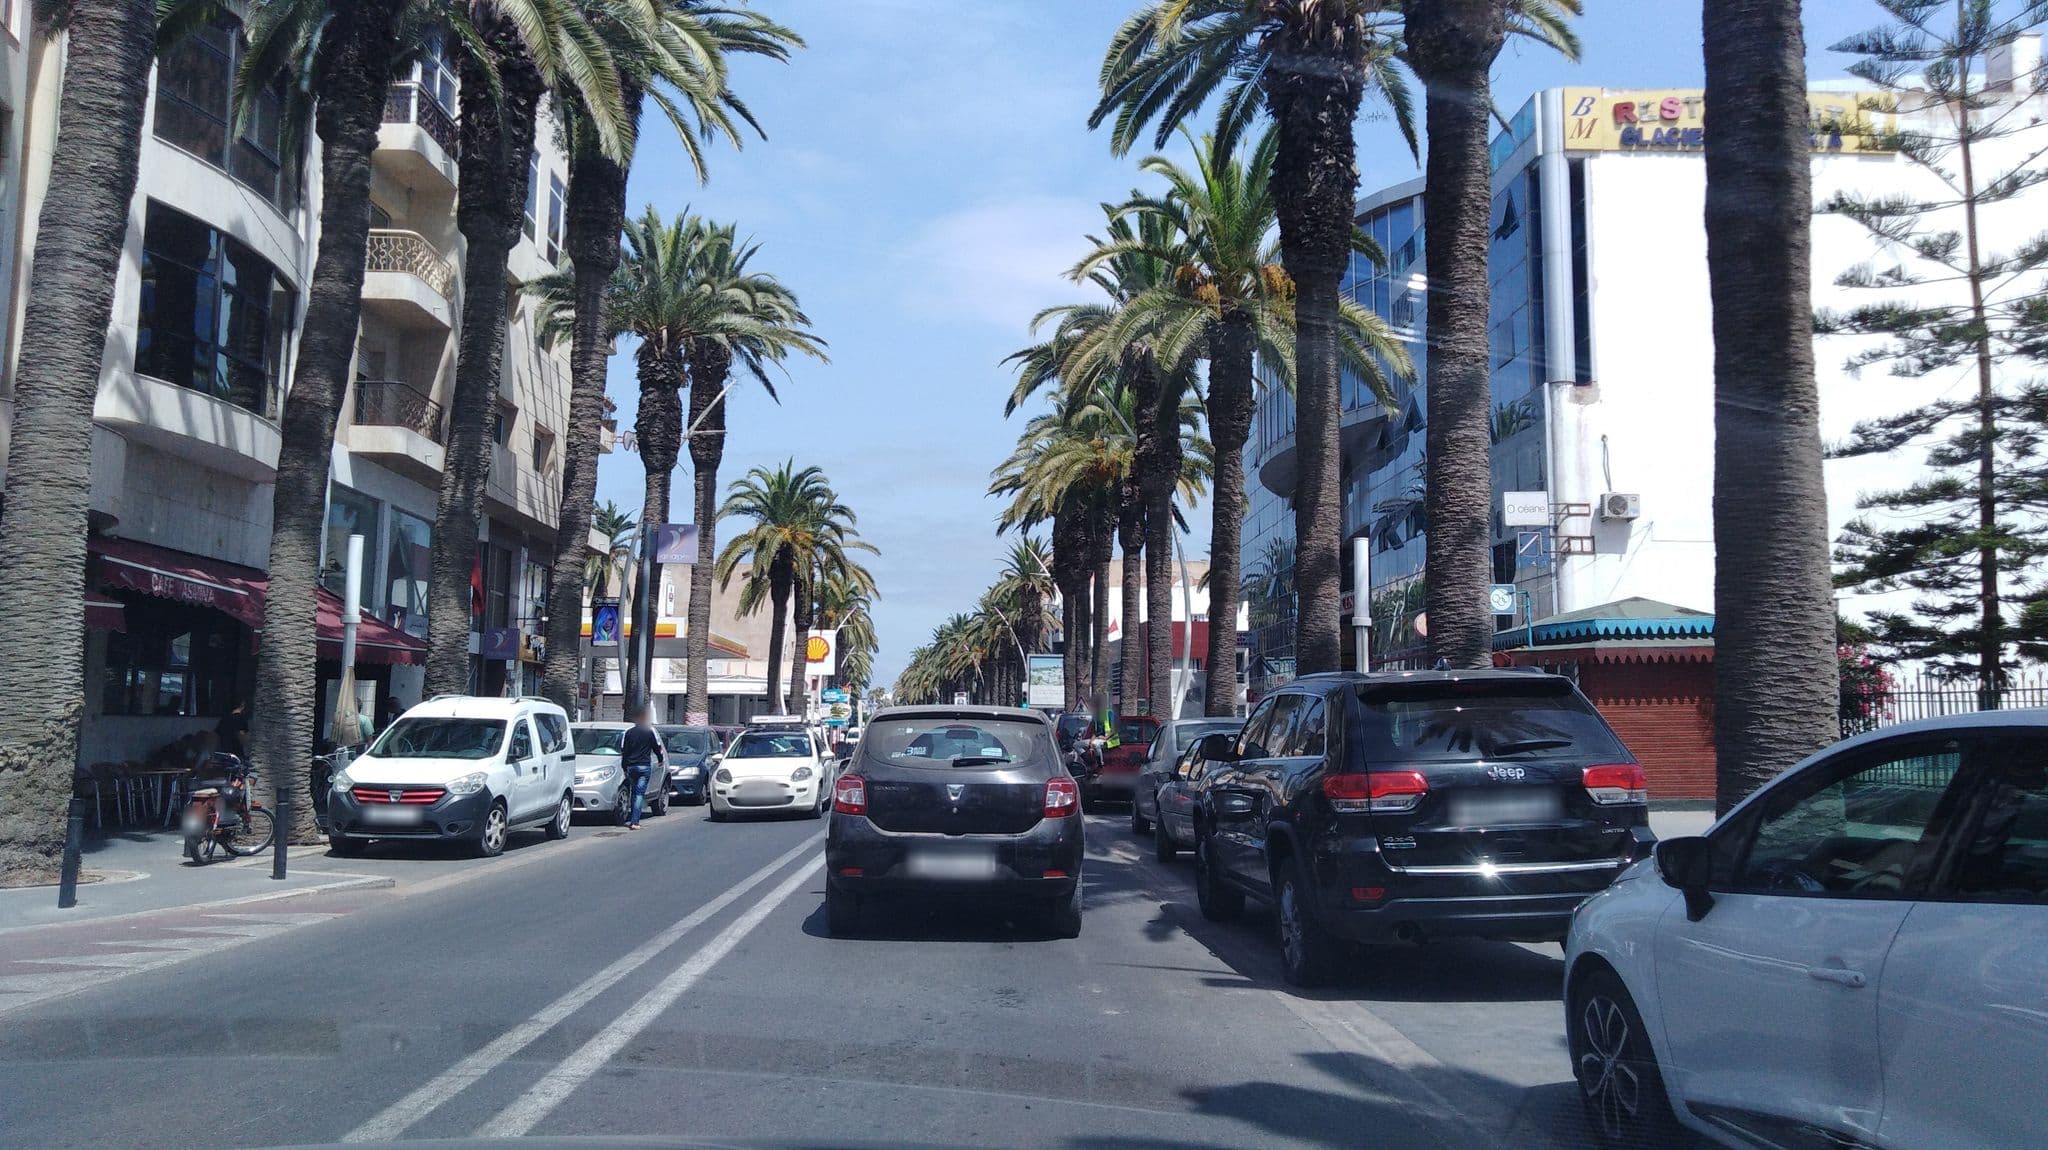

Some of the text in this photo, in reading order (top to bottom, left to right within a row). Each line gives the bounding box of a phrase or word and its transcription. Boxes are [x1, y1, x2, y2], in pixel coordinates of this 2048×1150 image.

[1571, 96, 1596, 116] B
[1569, 118, 1598, 139] M
[1620, 126, 1705, 147] GLACIE
[1488, 765, 1526, 780] Jeep
